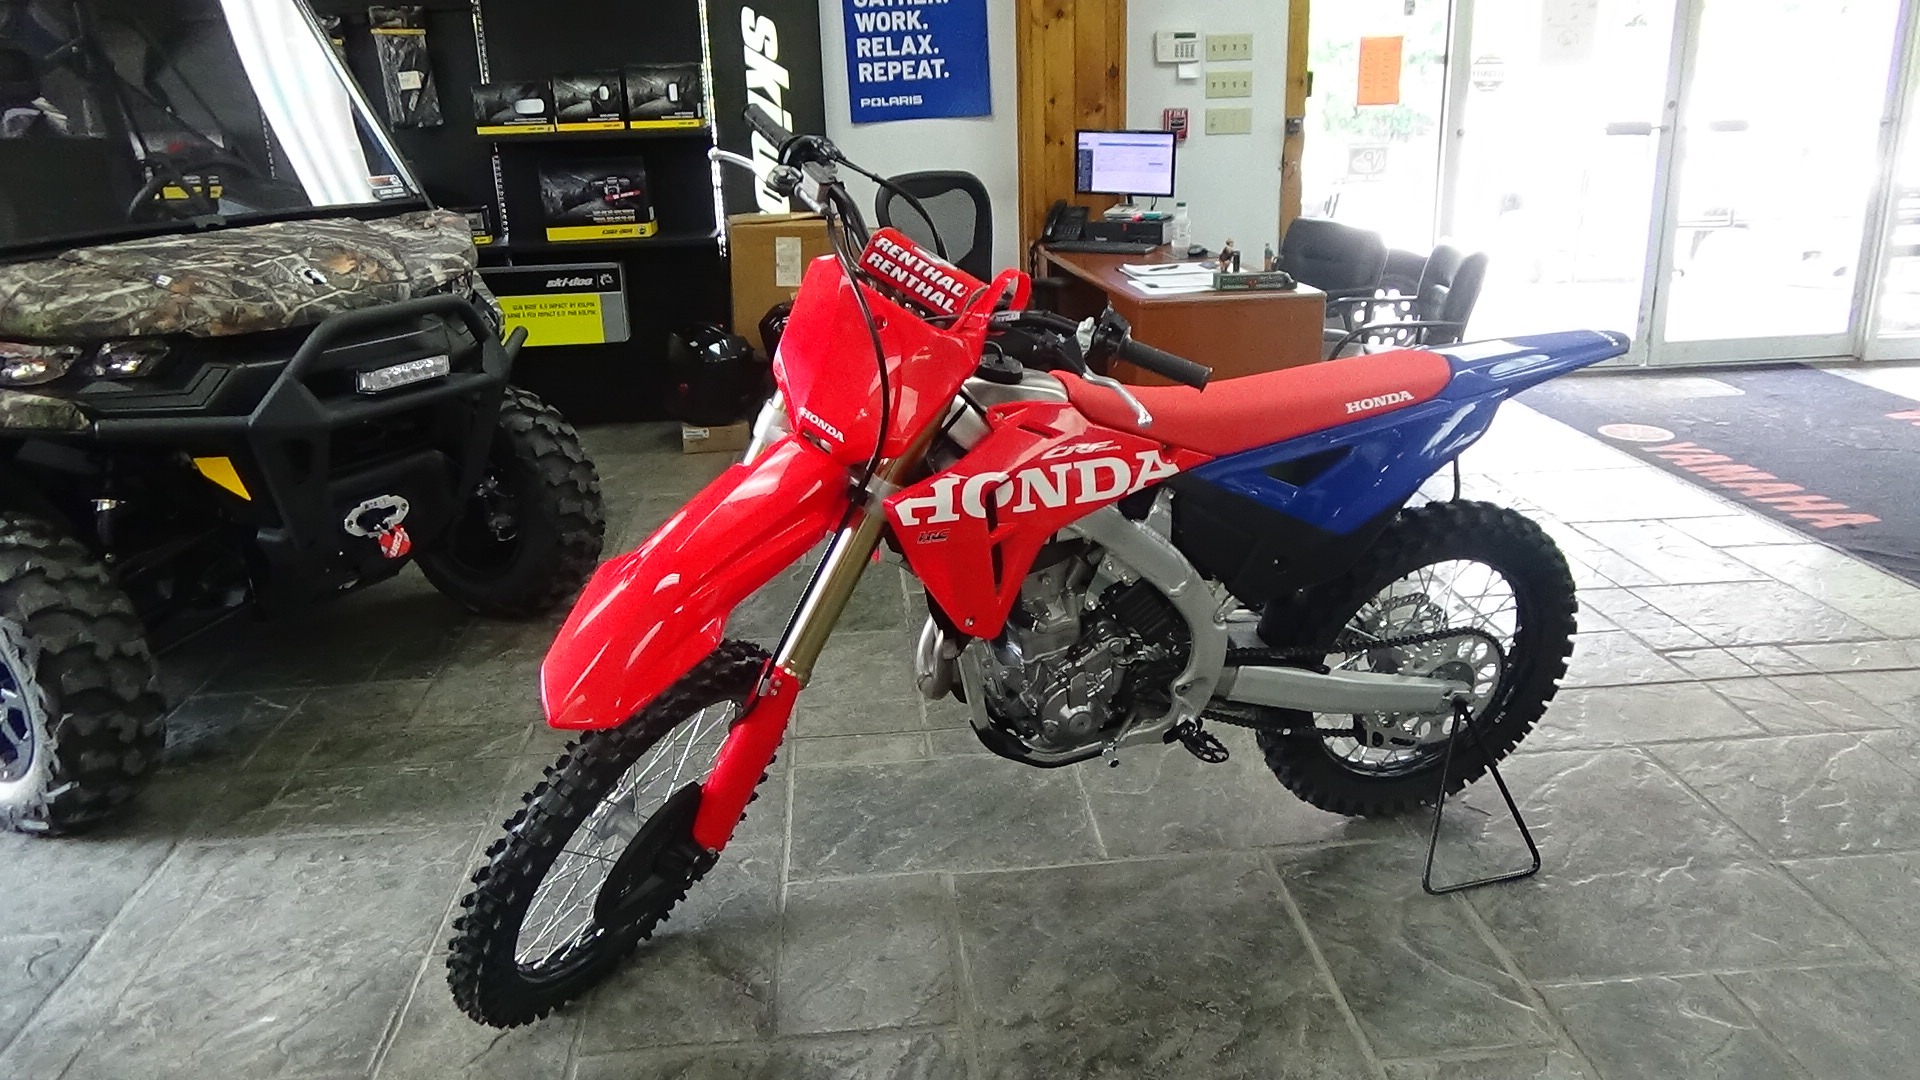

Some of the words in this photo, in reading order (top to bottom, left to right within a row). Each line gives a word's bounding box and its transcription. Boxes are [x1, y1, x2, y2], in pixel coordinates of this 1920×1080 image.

[854, 10, 928, 33] WORK.
[856, 34, 939, 58] RELAX.
[858, 58, 949, 82] REPEAT.
[860, 95, 923, 108] POLARIS
[874, 236, 967, 298] RENTHAL
[866, 252, 955, 314] RENTHAL
[1345, 390, 1415, 414] HONDA
[797, 406, 845, 443] HONDA
[894, 449, 1180, 527] HONDA
[1641, 441, 1882, 529] YAMAHA
